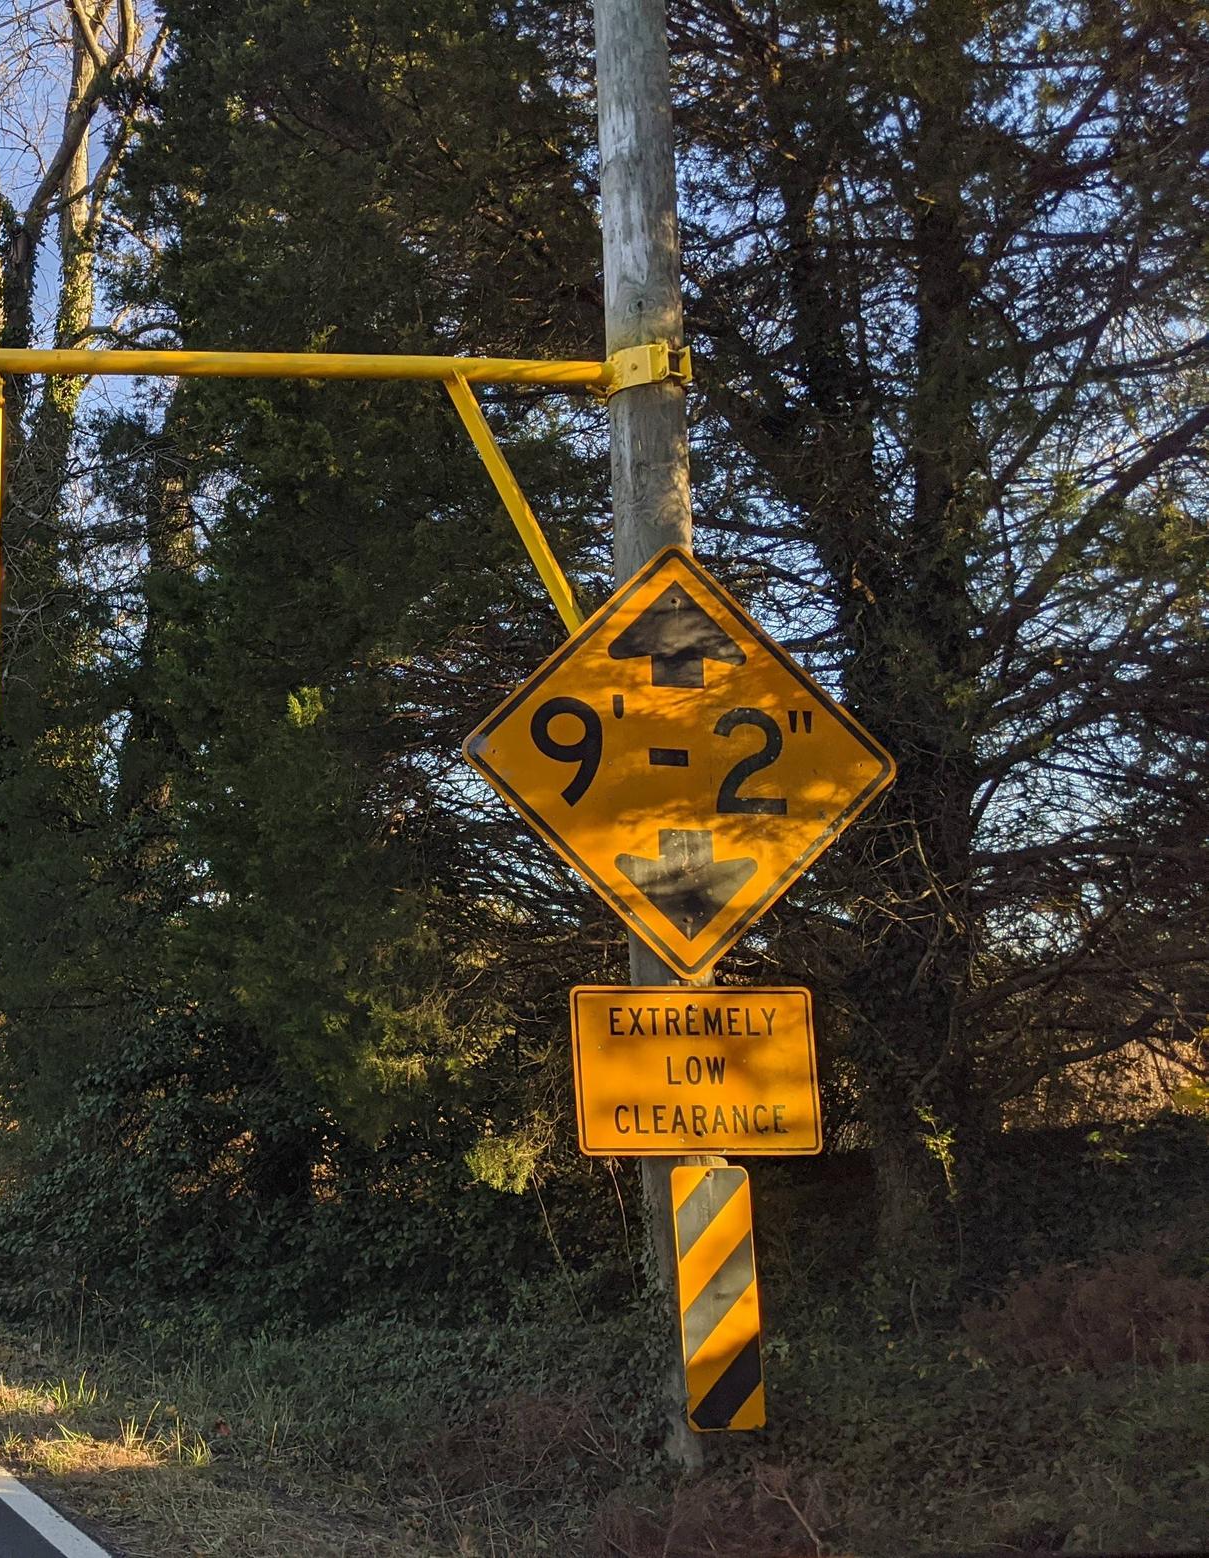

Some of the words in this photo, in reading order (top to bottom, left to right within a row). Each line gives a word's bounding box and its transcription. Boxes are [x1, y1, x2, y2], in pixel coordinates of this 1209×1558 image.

[608, 1007, 777, 1036] EXTREMELY
[666, 1055, 726, 1085] LOW
[614, 1104, 789, 1135] CLEARANCE
